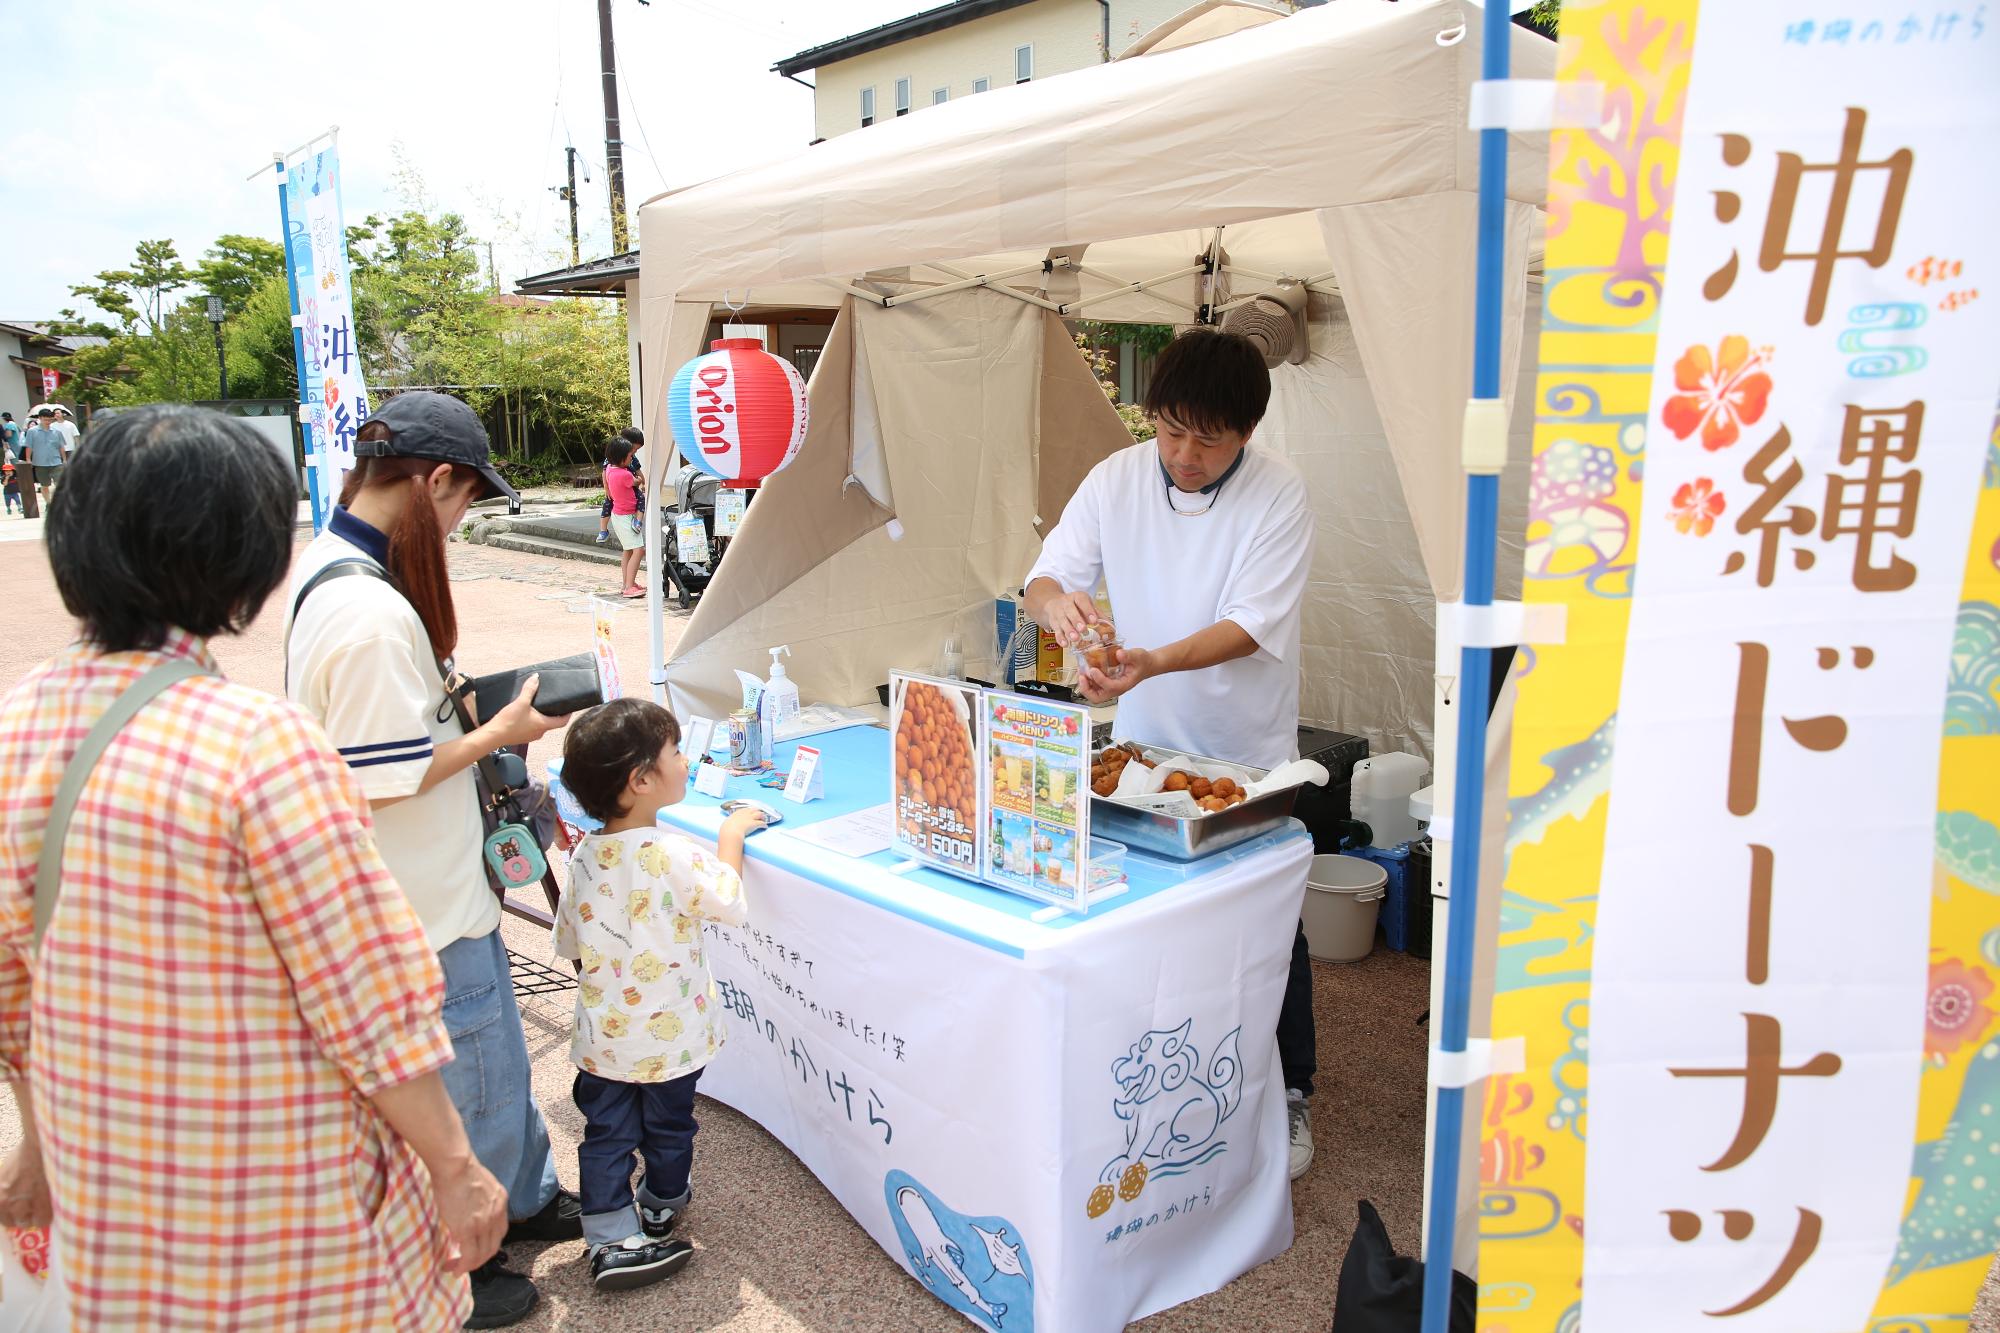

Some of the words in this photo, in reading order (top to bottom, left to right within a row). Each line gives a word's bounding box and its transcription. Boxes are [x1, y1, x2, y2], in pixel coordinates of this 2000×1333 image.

[323, 314, 368, 474] 沖縄
[697, 365, 735, 455] Orion
[1018, 724, 1045, 738] MENU
[1658, 106, 1926, 1318] 沖縄ドーナツ
[931, 831, 974, 865] 500円
[736, 921, 815, 979] が好きすぎて
[1104, 1185, 1211, 1244] 珊瑚のかけら
